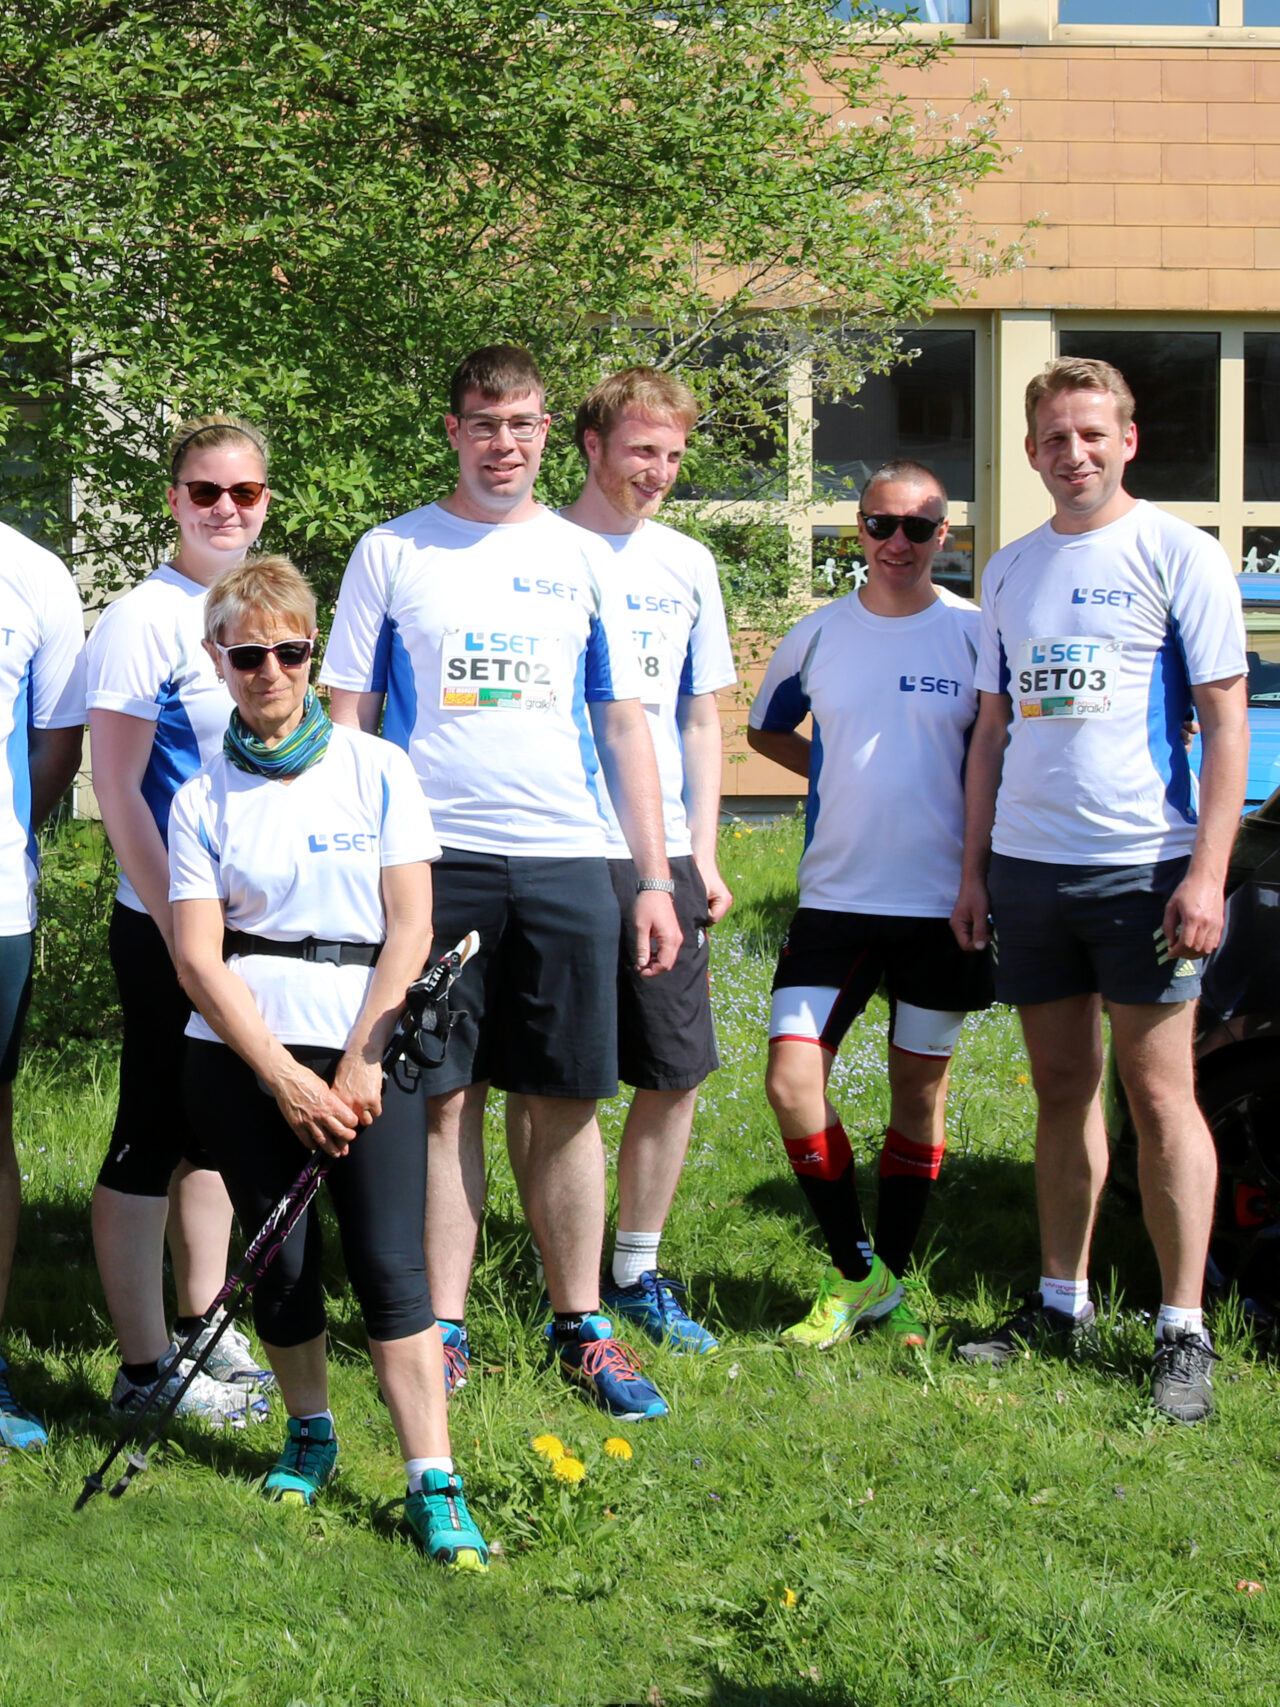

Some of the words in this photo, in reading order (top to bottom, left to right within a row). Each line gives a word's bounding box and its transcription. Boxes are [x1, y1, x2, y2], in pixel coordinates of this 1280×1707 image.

[535, 579, 578, 602] SET
[1090, 588, 1138, 608] SET
[644, 595, 682, 615] SET
[489, 632, 540, 656] SET
[1049, 643, 1100, 663] SET
[447, 657, 551, 685] SET02
[1019, 667, 1107, 694] SET03
[920, 675, 962, 697] SET
[332, 832, 378, 854] SET
[423, 964, 445, 993] LEKI
